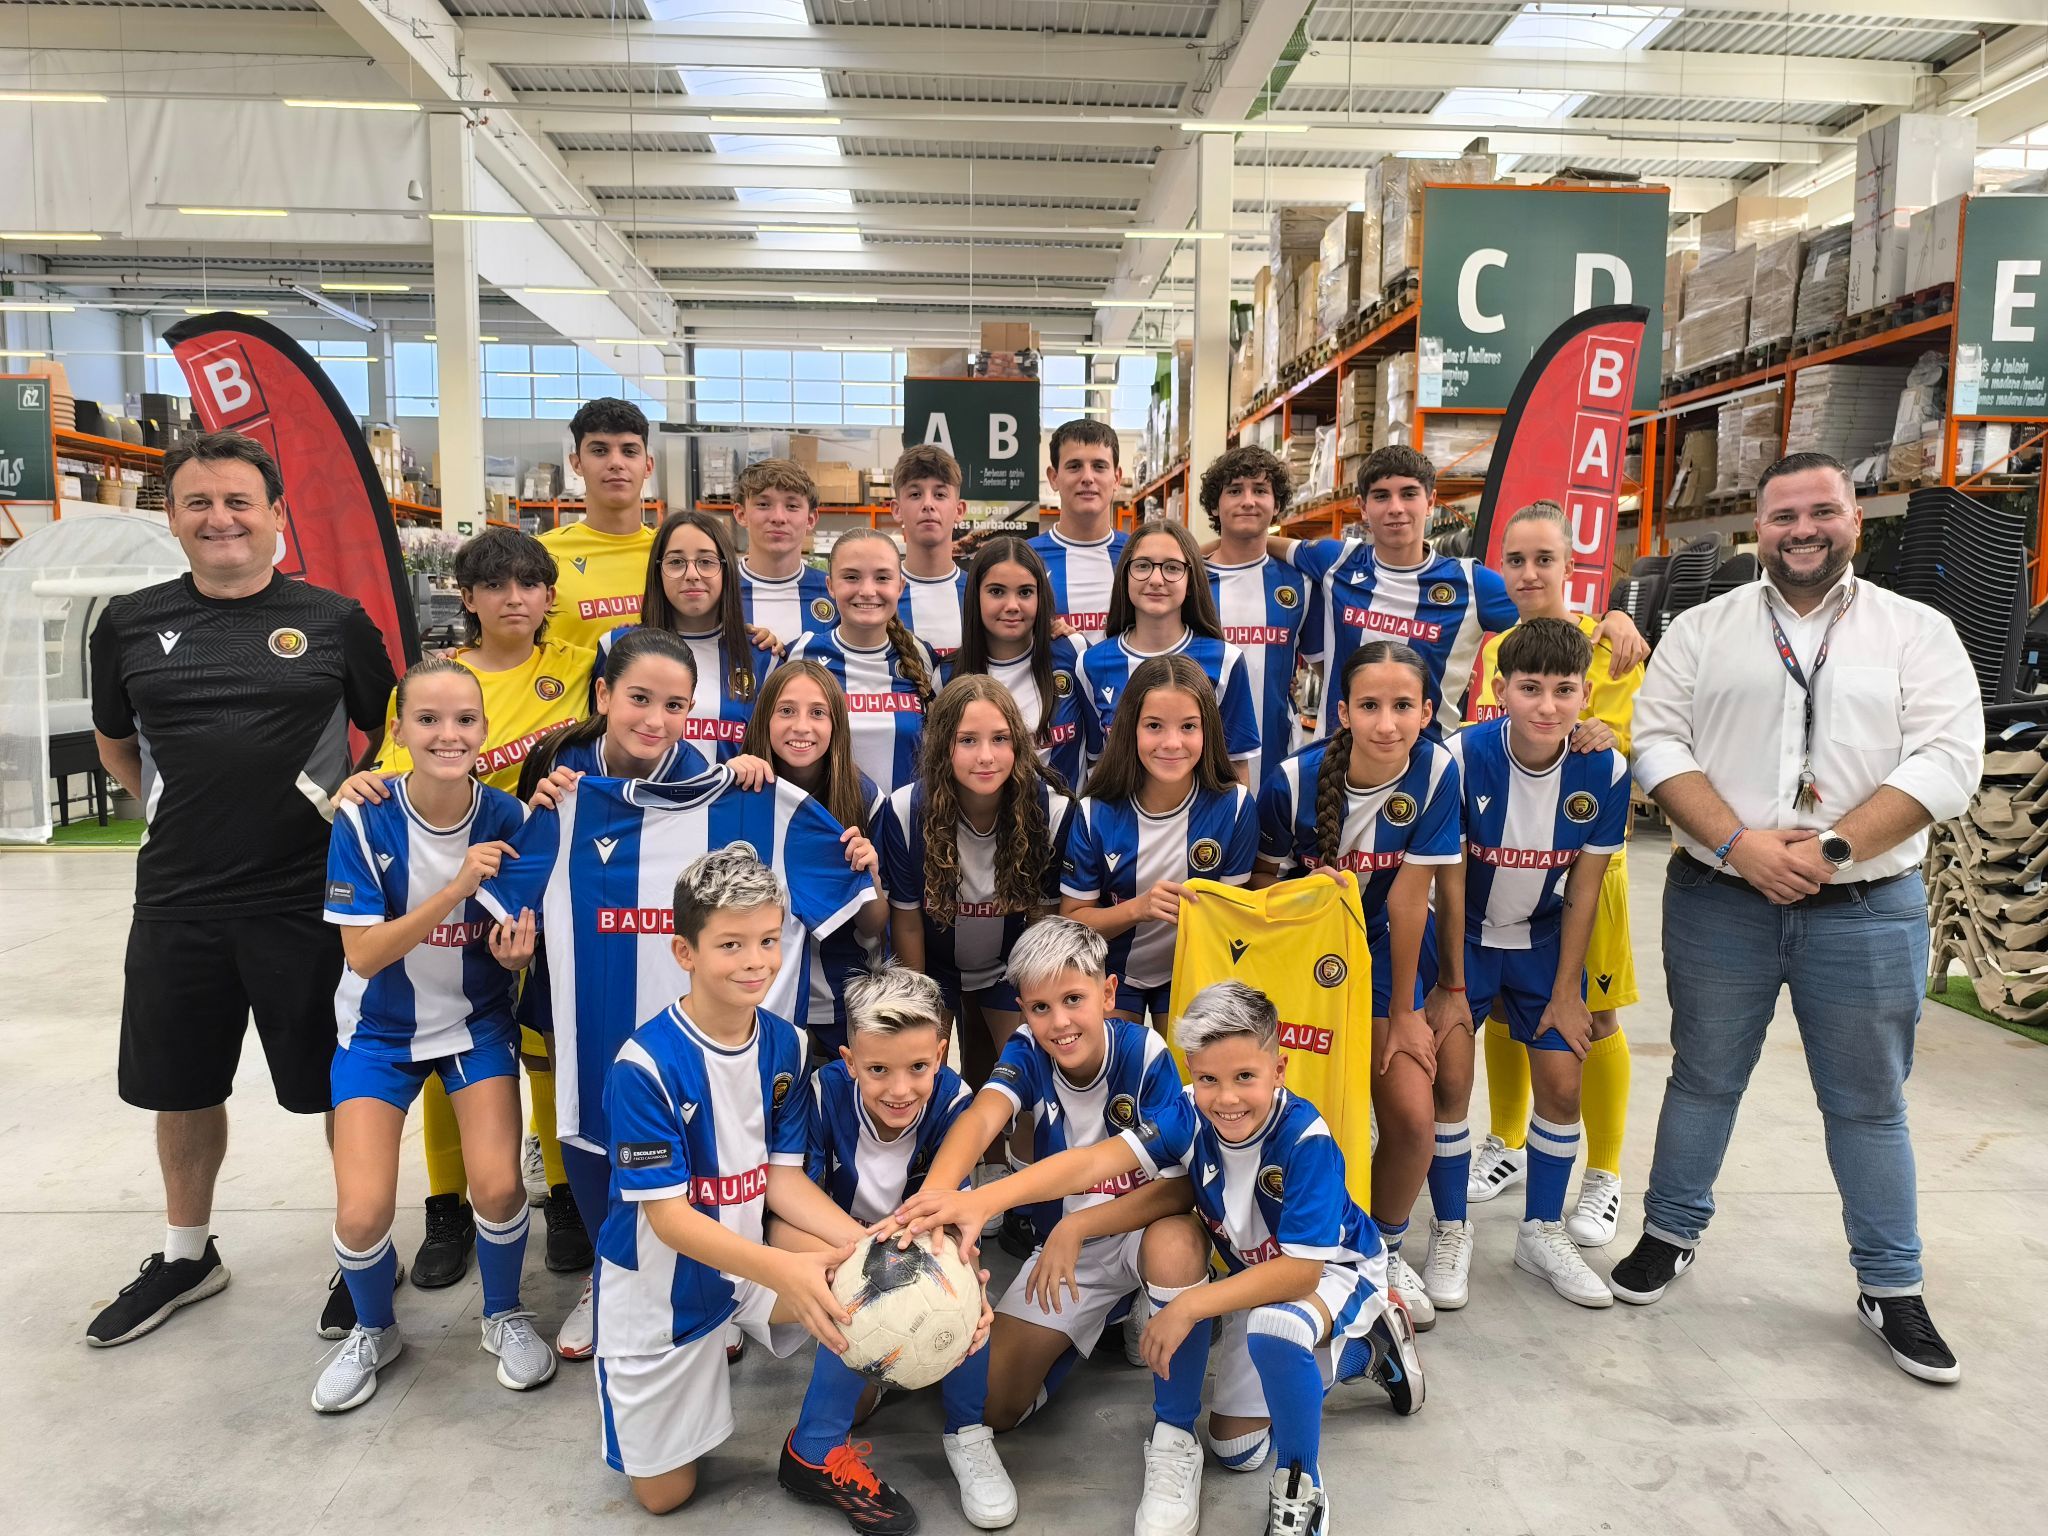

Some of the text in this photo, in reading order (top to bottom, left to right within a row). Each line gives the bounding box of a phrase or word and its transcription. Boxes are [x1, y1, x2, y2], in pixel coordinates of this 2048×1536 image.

[1458, 248, 1633, 333] C D
[1992, 260, 2041, 341] E
[203, 357, 251, 414] B
[23, 389, 40, 407] 62
[924, 412, 1018, 459] A B
[1563, 348, 1624, 615] BAUH
[985, 506, 1009, 517] para
[974, 519, 1028, 530] barbacoas
[580, 597, 639, 617] BAUH
[1345, 608, 1439, 640] BAUHAUS
[1224, 628, 1289, 643] UHAUS
[852, 695, 921, 710] UHAUS
[686, 721, 745, 739] HAUS
[601, 911, 675, 930] BAUH
[1281, 1026, 1330, 1050] AUS
[1104, 1168, 1149, 1190] AUS
